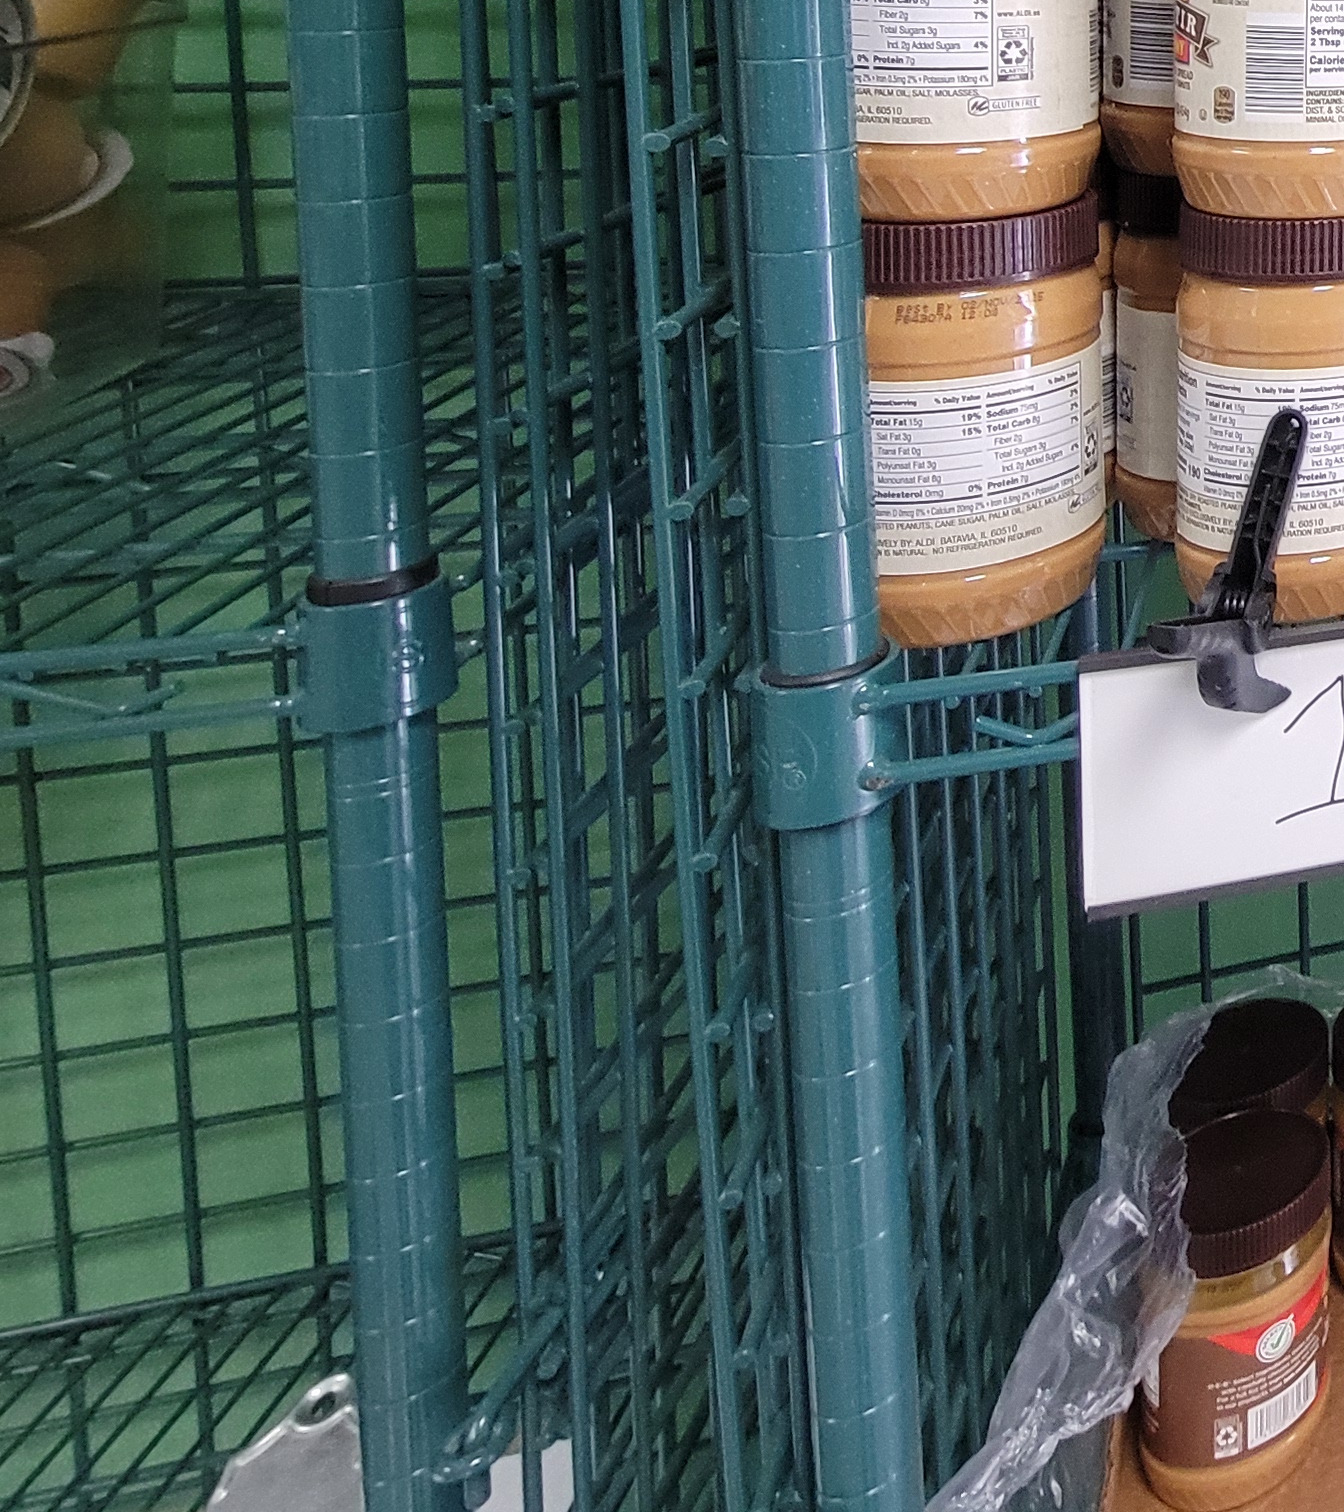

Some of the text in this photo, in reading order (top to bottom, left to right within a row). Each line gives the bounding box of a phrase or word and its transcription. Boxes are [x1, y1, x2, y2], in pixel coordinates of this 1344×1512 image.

[880, 10, 987, 19] Fiber 7%
[1311, 27, 1344, 36] Serving
[873, 56, 903, 64] Protein
[992, 100, 1019, 109] GLUTEN
